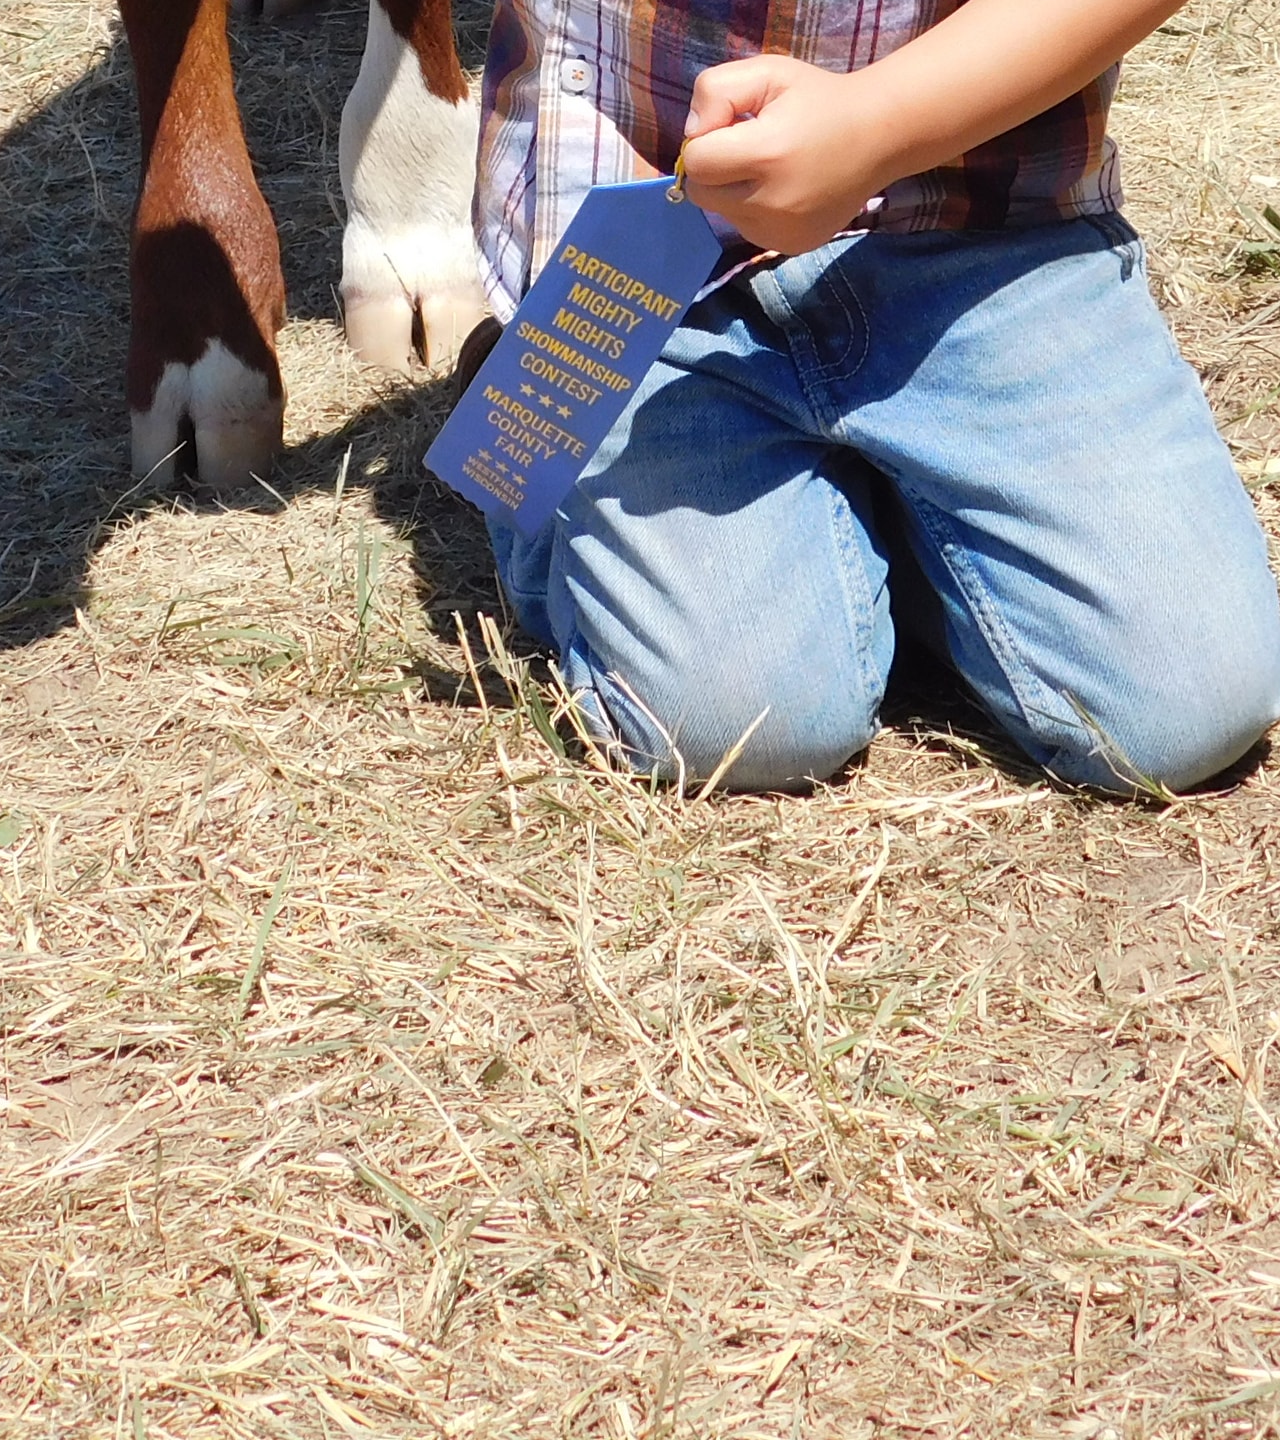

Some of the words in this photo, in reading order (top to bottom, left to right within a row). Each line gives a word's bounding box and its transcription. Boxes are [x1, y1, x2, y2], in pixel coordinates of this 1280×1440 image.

[558, 244, 682, 322] PARTICIPANT
[567, 282, 643, 334] MIGHTY
[516, 321, 632, 392] SHOWMANSHIP
[551, 307, 626, 359] MIGHTS
[520, 352, 603, 407] CONTEST
[482, 385, 587, 458] MARQUETTE
[487, 411, 557, 460] COUNTY
[468, 455, 524, 501] WESTFIELD
[495, 436, 533, 469] FAIR
[462, 464, 519, 511] WISCONSIN
